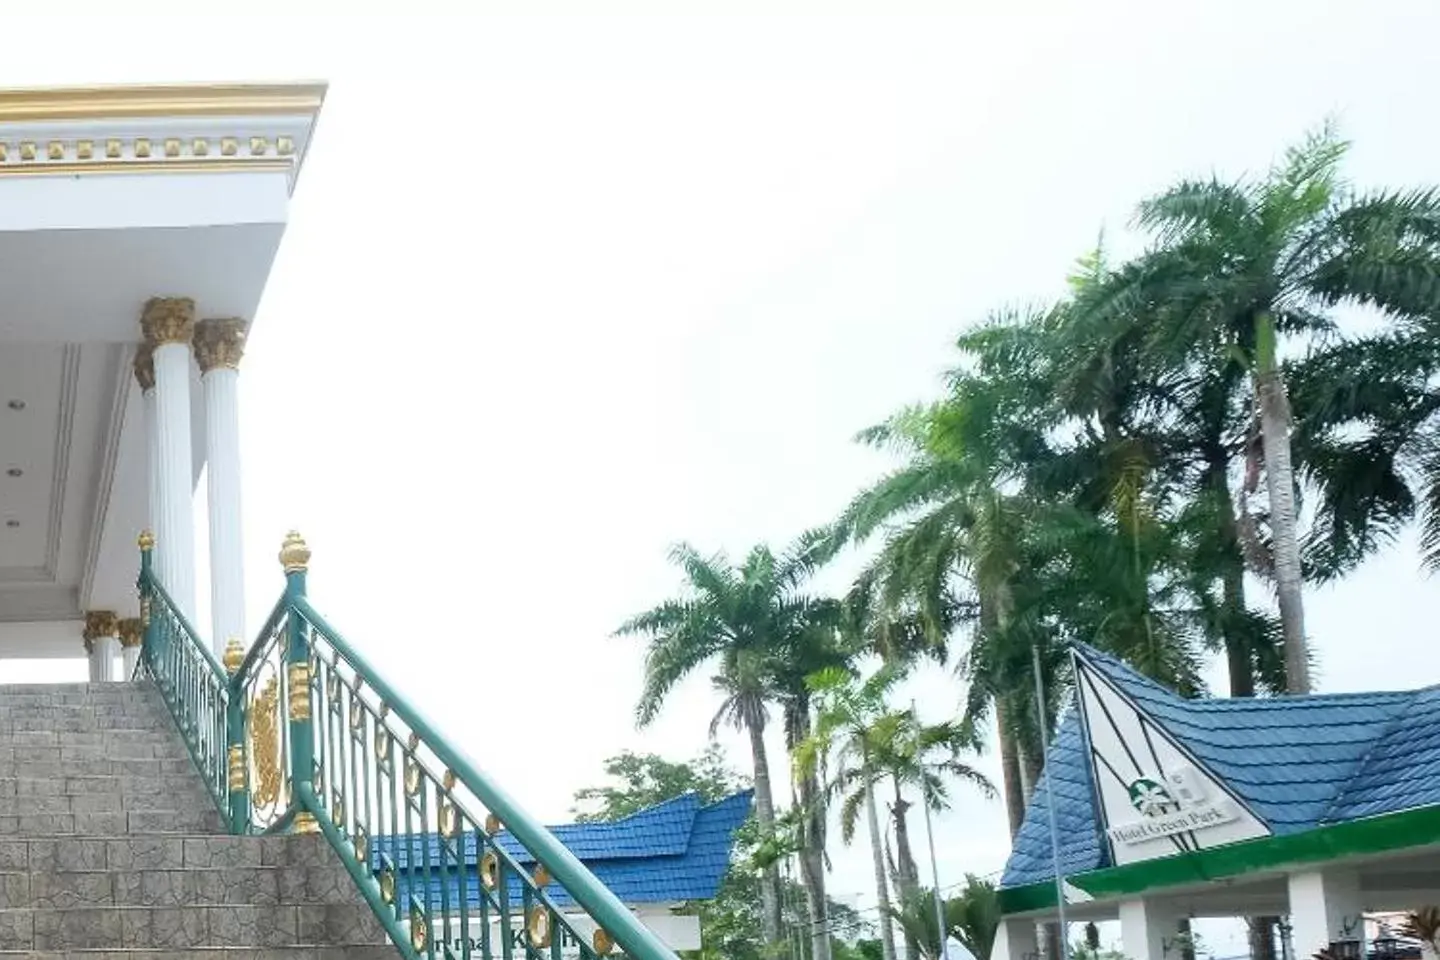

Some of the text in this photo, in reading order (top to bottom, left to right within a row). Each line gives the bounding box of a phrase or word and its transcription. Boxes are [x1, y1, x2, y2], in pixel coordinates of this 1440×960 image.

[1113, 807, 1224, 842] Hotel Green Park
